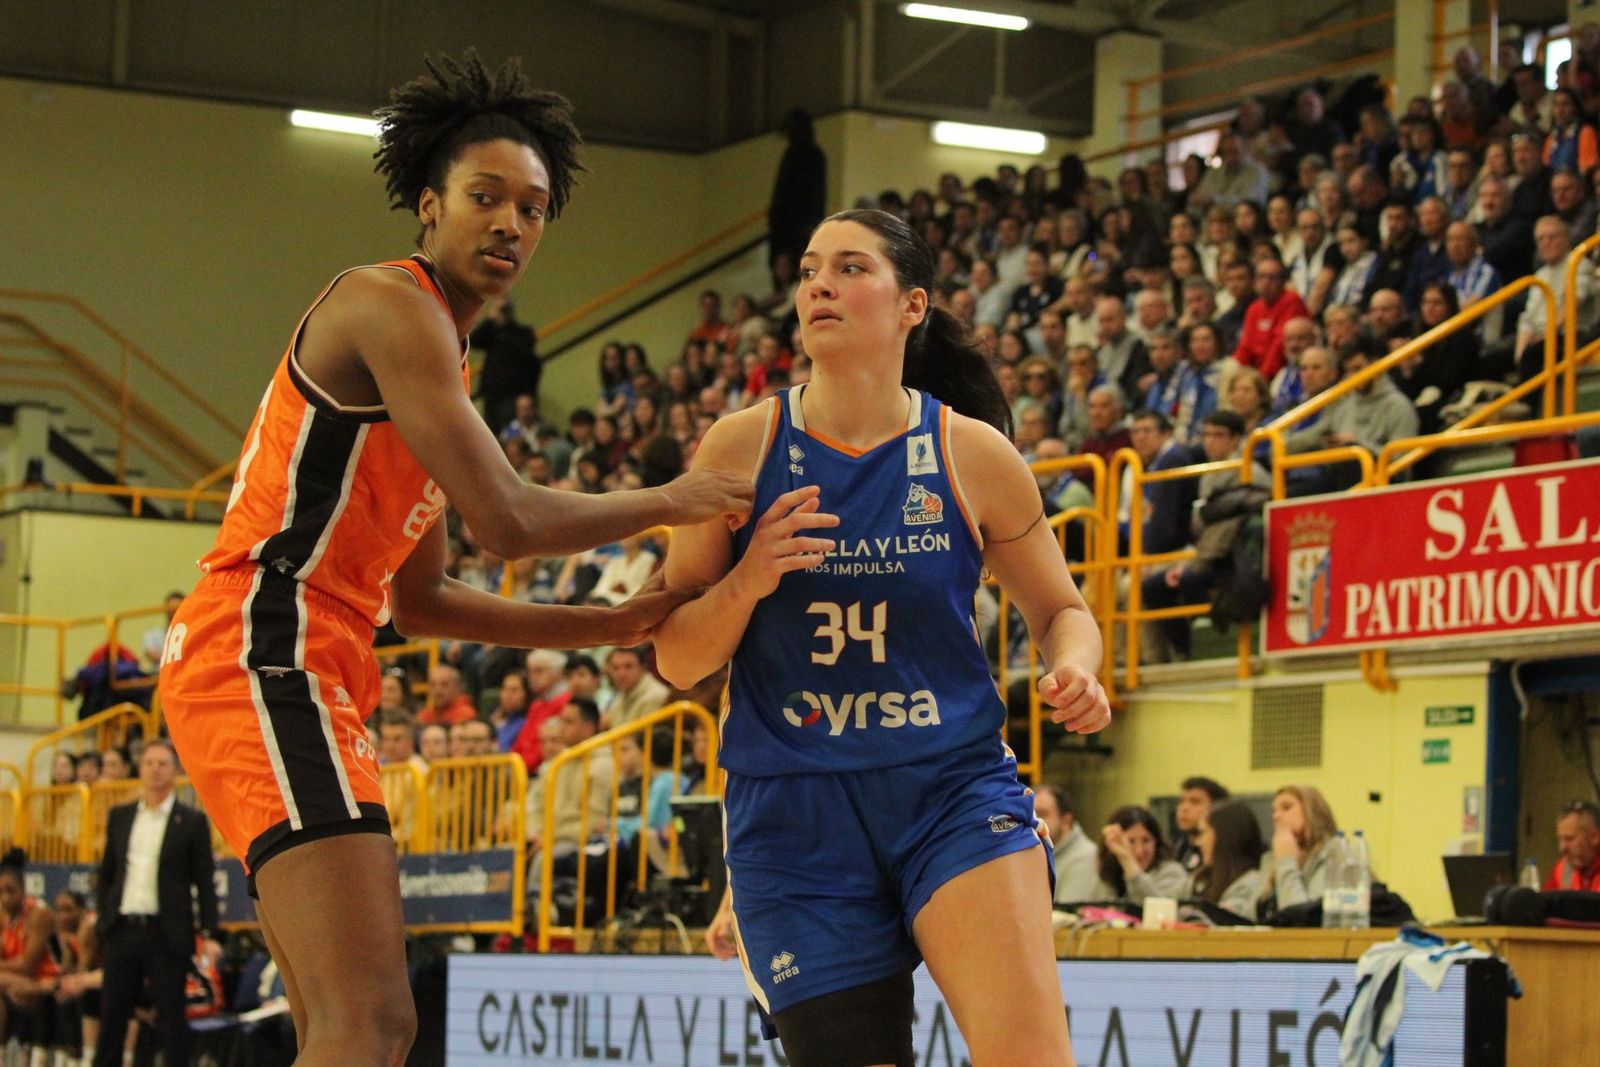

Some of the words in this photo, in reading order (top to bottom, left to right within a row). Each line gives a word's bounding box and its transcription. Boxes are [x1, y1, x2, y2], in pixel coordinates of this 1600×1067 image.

[905, 512, 942, 524] AVENIDA
[1424, 476, 1600, 561] SAL
[875, 537, 891, 558] Y
[895, 528, 951, 554] LEÓN
[833, 560, 905, 578] IMPULSA
[805, 600, 887, 666] 34
[478, 992, 654, 1062] CASTILLA
[675, 995, 700, 1067] Y
[718, 996, 790, 1067] LE
